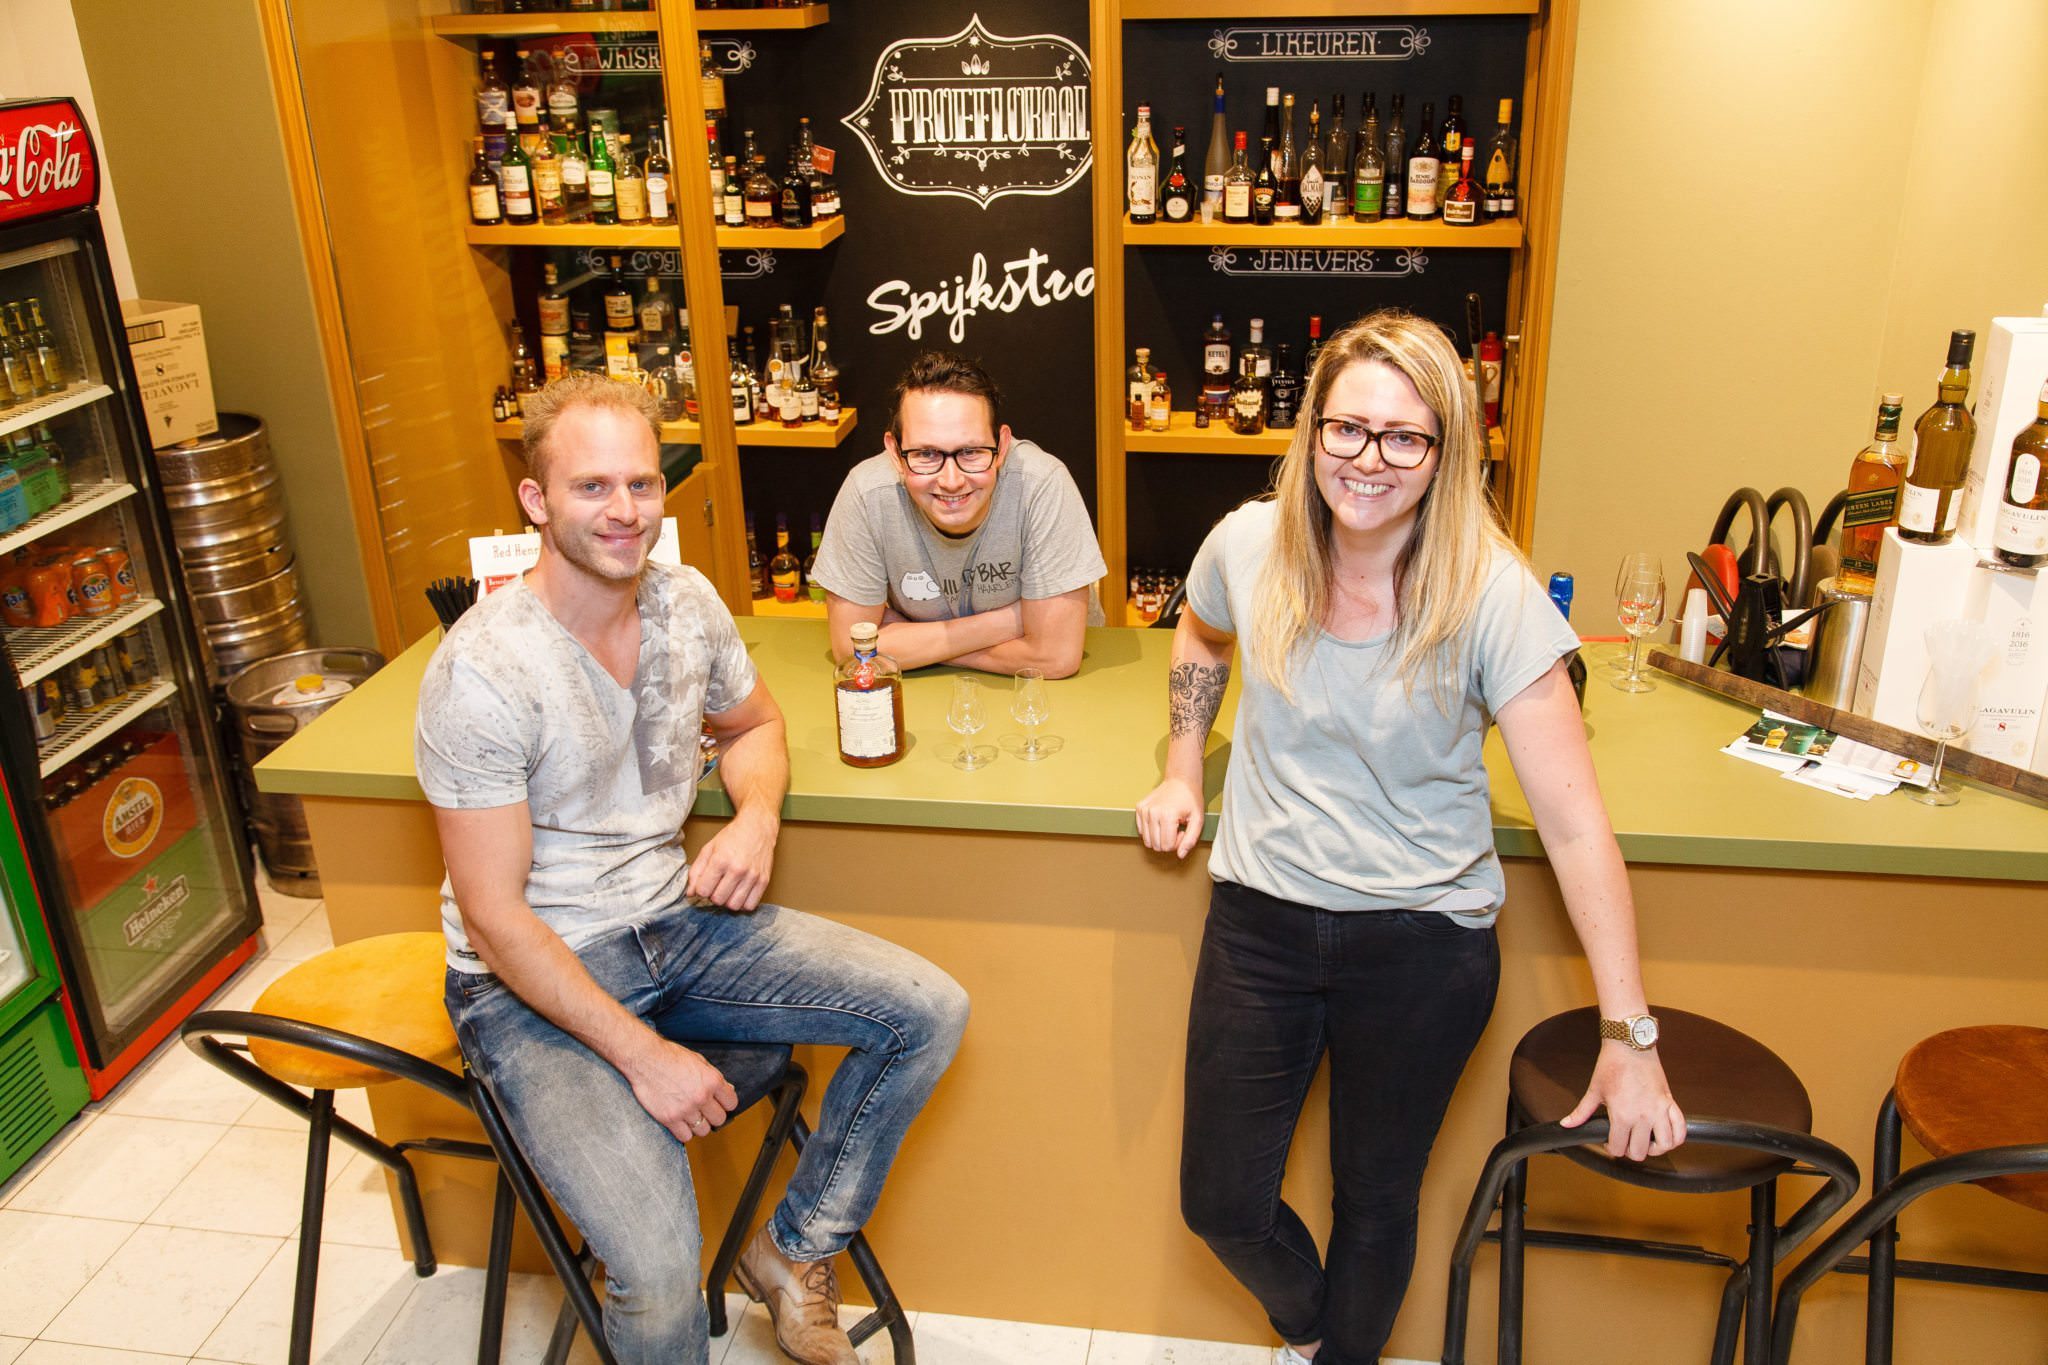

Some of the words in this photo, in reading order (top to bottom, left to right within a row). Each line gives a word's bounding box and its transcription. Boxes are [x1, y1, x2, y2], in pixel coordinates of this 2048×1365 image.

[1261, 31, 1377, 56] LIKEUREN
[889, 85, 1091, 144] PROEFLOKAAL
[1254, 249, 1374, 272] JENEVERS
[867, 247, 1095, 344] Spijkstra
[143, 379, 199, 400] LAGAVUL
[1871, 499, 1894, 508] LABEL
[492, 544, 511, 559] Red
[515, 543, 538, 558] Henr
[976, 561, 1016, 582] BAR
[2009, 640, 2029, 648] 2016
[2011, 631, 2031, 639] 1816
[1997, 721, 2006, 732] 8
[115, 796, 151, 828] AMSTEL
[128, 886, 186, 937] Heineken
